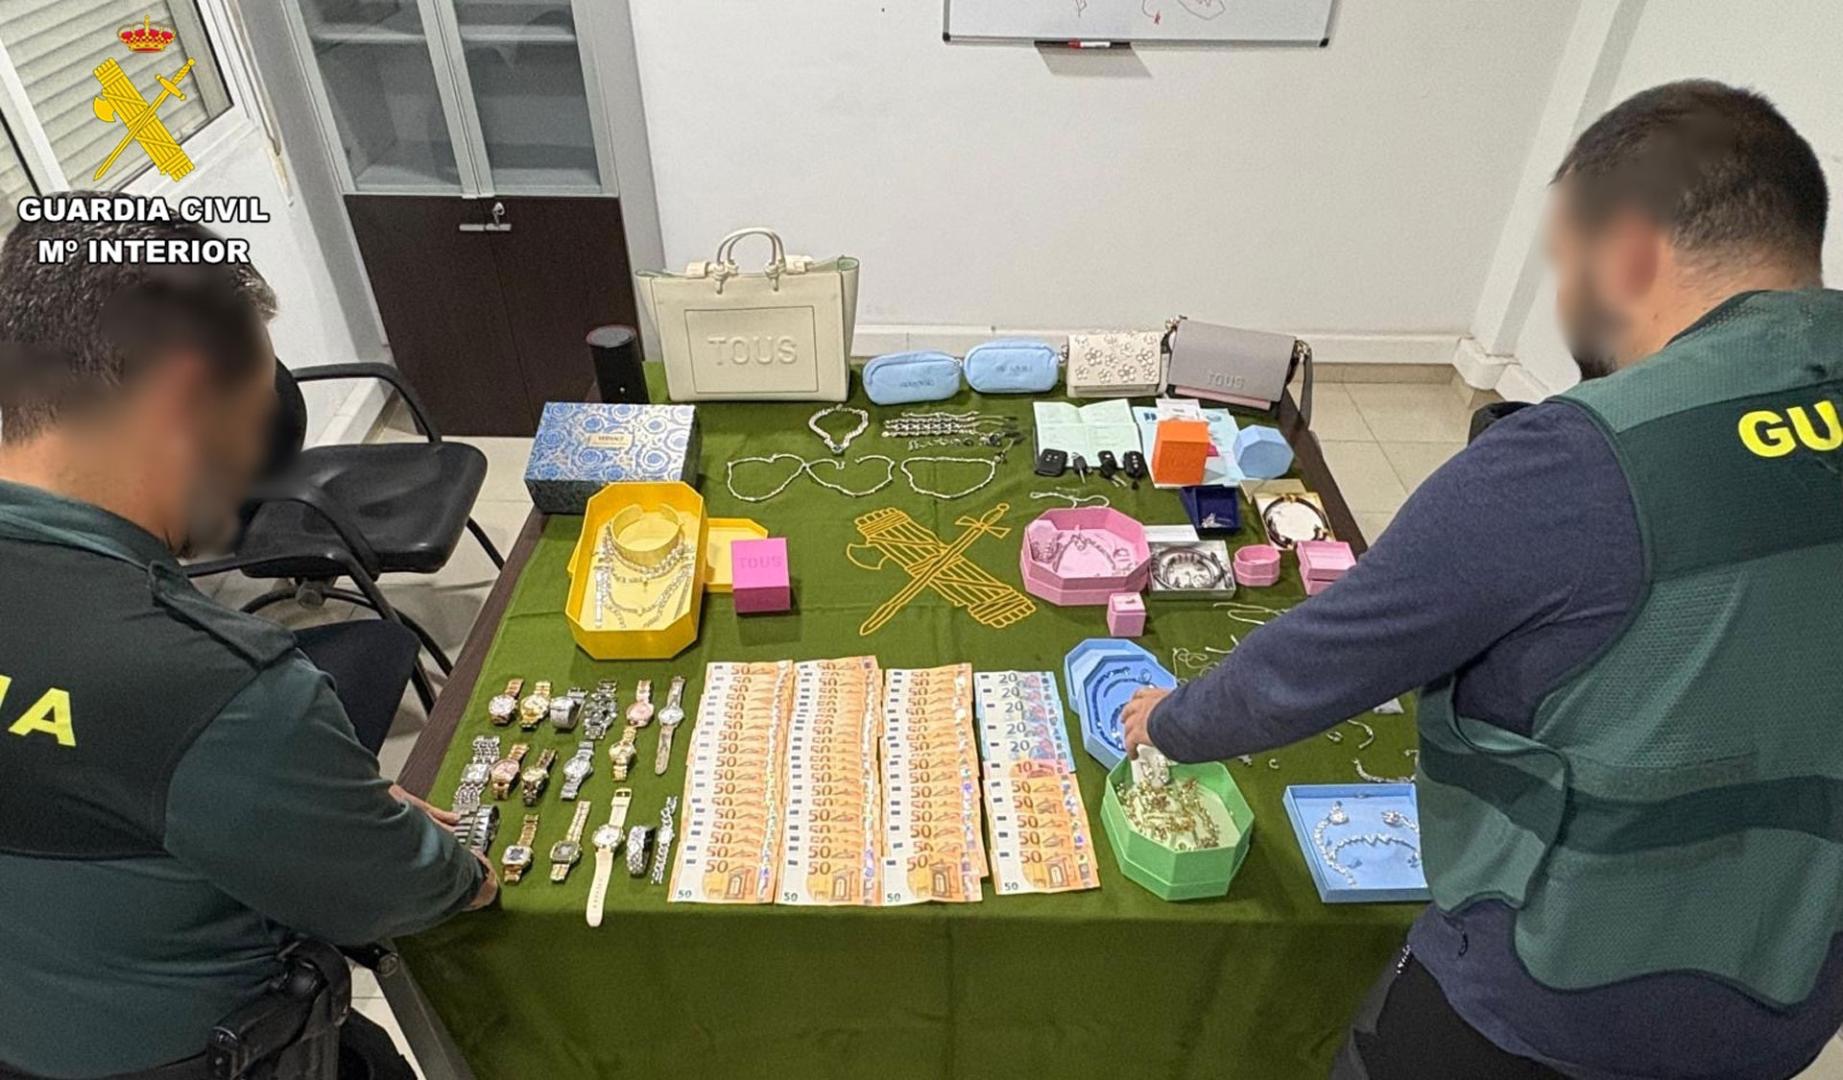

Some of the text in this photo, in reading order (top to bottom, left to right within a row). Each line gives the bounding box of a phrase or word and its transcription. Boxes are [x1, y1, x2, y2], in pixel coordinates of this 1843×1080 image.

[707, 335, 798, 367] TOUS
[738, 555, 784, 569] TOUS
[731, 665, 750, 675] 50
[999, 672, 1018, 684] 20
[1001, 686, 1021, 698] 20
[1005, 701, 1024, 713] 20
[723, 720, 743, 730] 50
[1006, 722, 1026, 734] 20
[717, 730, 738, 741] 50
[718, 742, 738, 754] 50
[1010, 740, 1030, 752] 20
[715, 756, 737, 767] 50
[908, 758, 930, 770] 50
[1014, 761, 1033, 773] 10
[713, 769, 735, 781] 50
[811, 772, 832, 782] 50
[910, 772, 930, 784] 50
[714, 782, 736, 794] 50
[811, 785, 832, 796] 50
[910, 786, 932, 798] 50
[1011, 780, 1031, 794] 50
[1012, 796, 1033, 809] 50
[715, 808, 736, 819] 50
[808, 808, 830, 822] 50
[911, 810, 932, 822] 50
[1016, 815, 1039, 828] 50
[910, 824, 932, 838] 50
[709, 832, 732, 844] 50
[1018, 831, 1040, 845] 50
[705, 846, 728, 858] 50
[808, 846, 831, 858] 50
[1020, 850, 1042, 864] 50
[704, 860, 728, 874] 50
[808, 861, 831, 875] 50
[907, 854, 928, 872] 50
[1004, 882, 1019, 890] 50
[678, 890, 692, 898] 50
[784, 892, 798, 902] 50
[887, 893, 901, 902] 50
